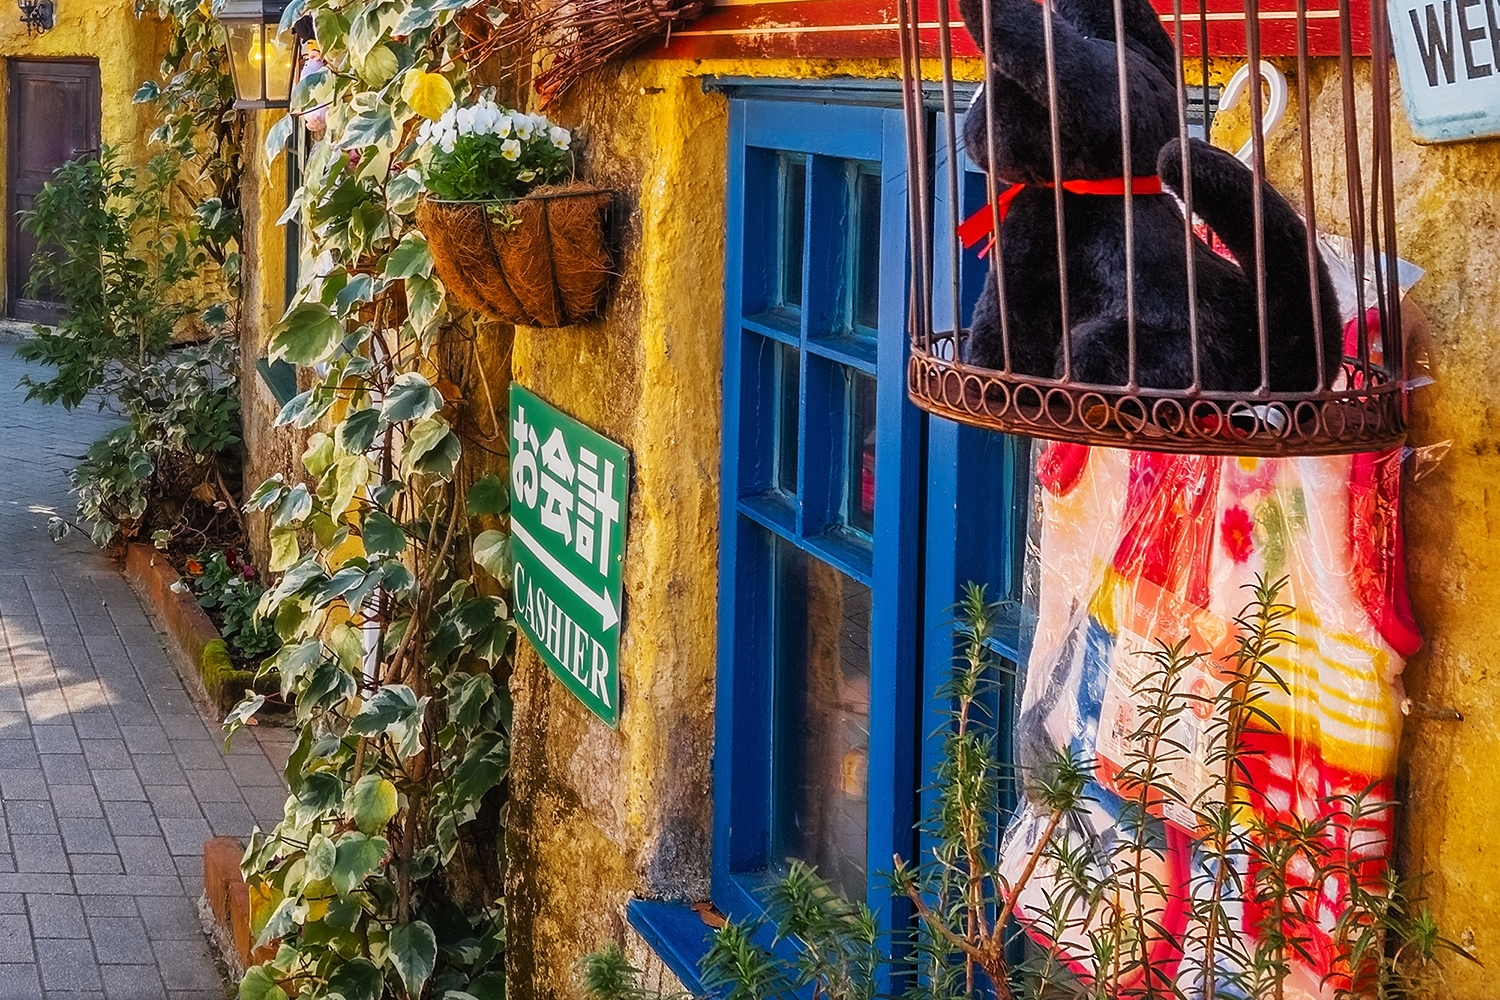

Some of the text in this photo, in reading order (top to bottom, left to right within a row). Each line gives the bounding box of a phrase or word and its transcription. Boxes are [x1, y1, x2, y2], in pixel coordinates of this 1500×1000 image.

[512, 404, 619, 578] お会計
[514, 562, 612, 709] CASHIER
